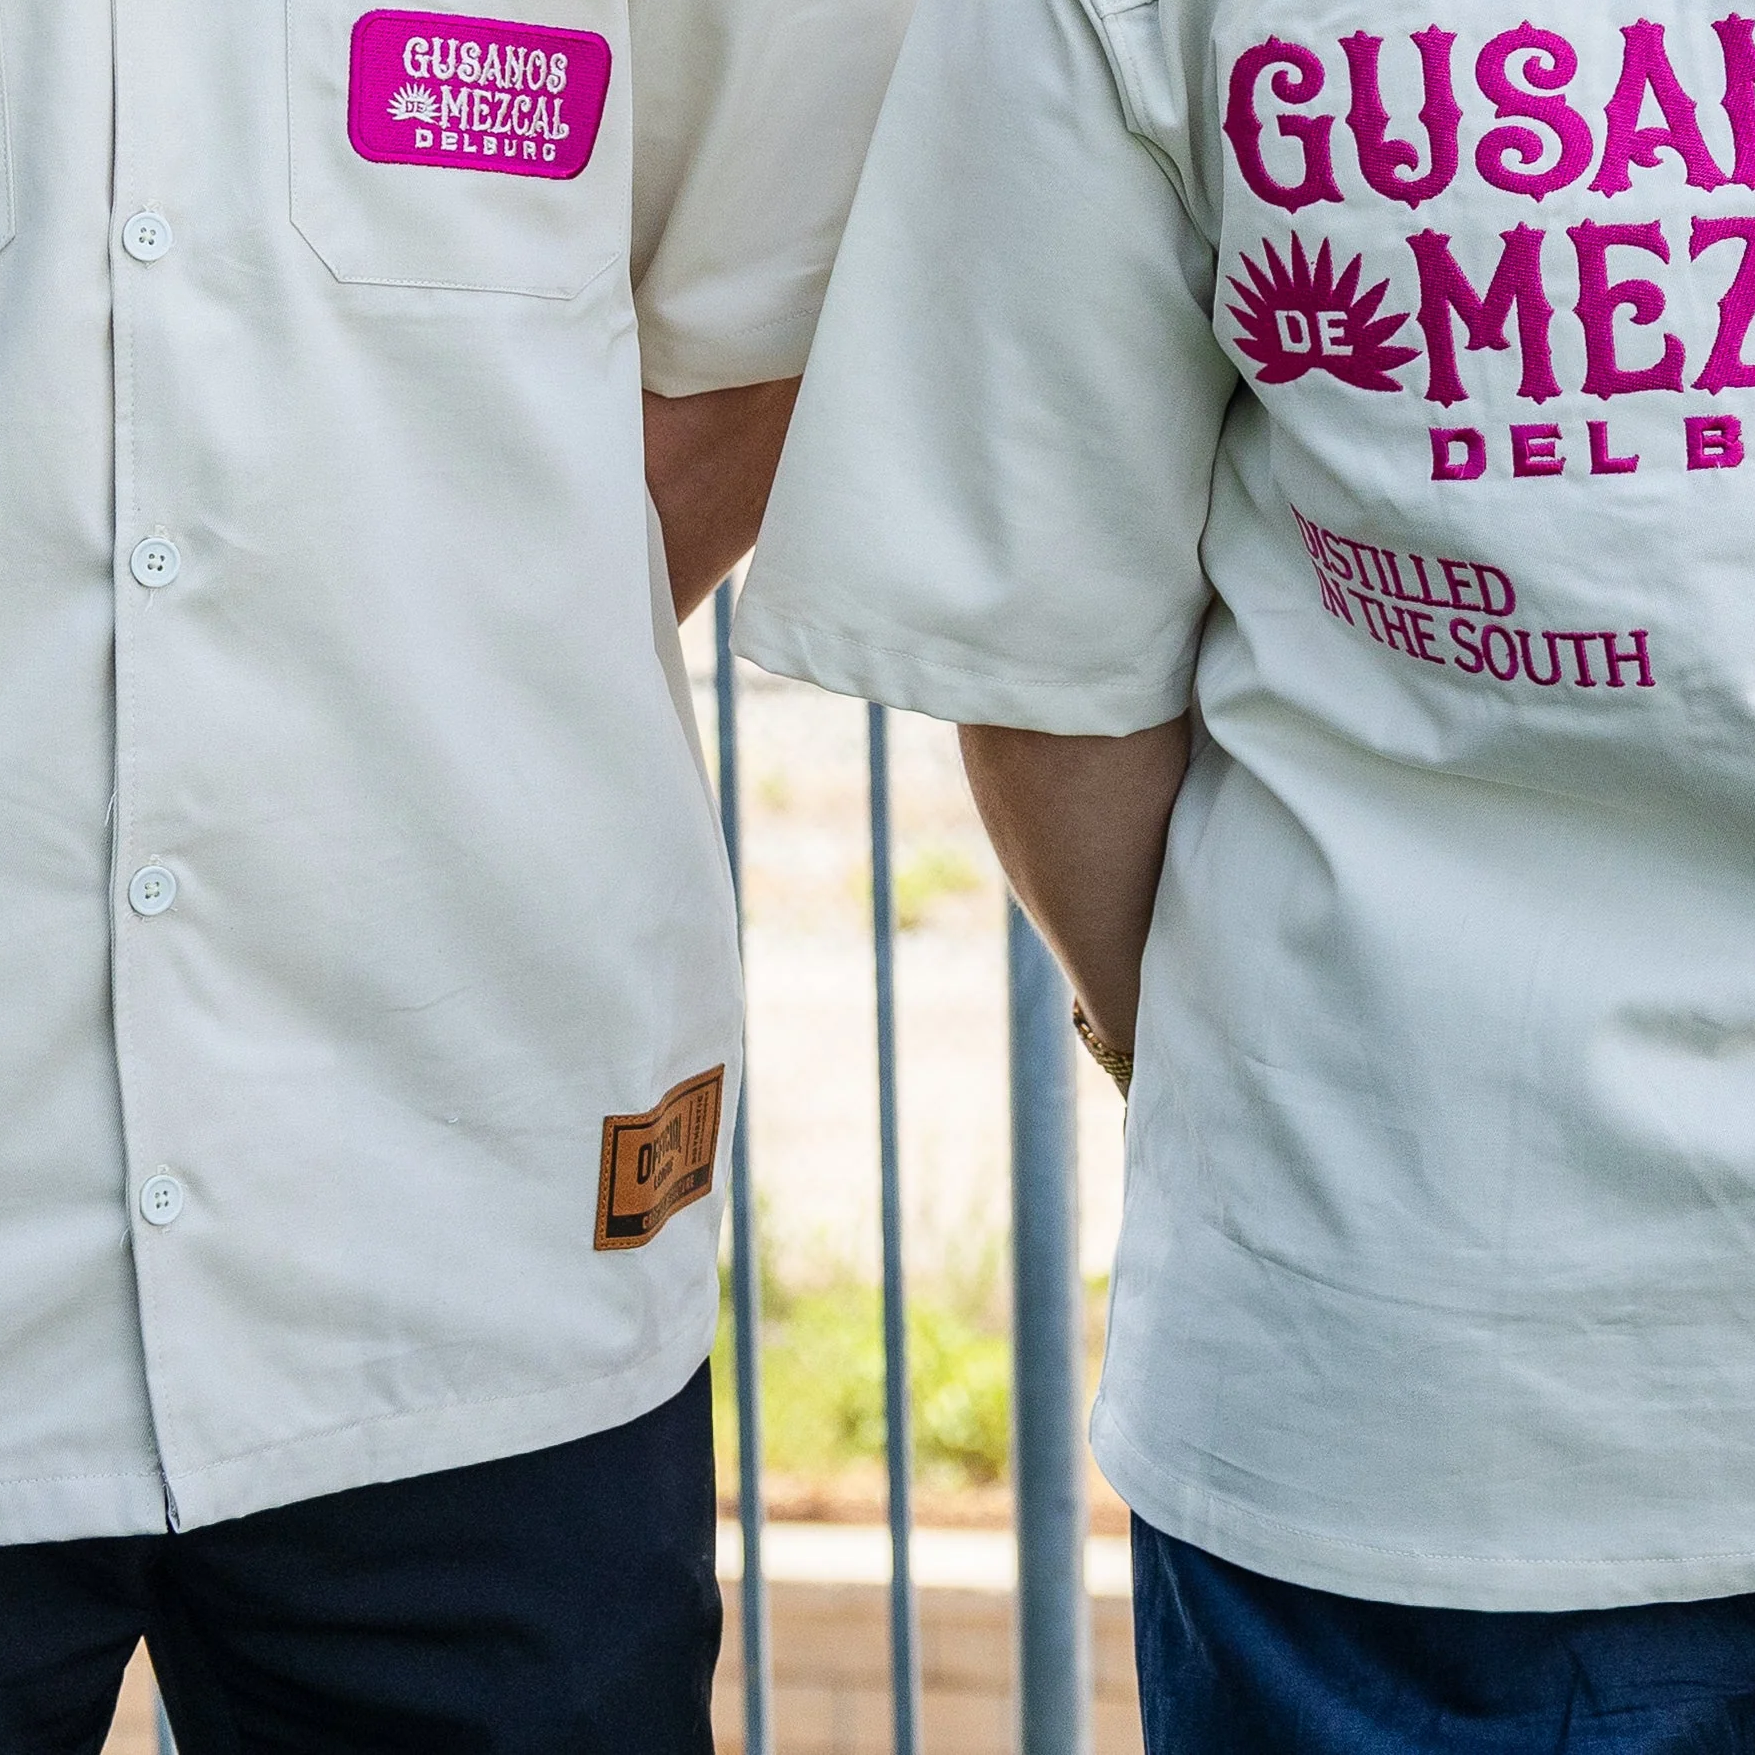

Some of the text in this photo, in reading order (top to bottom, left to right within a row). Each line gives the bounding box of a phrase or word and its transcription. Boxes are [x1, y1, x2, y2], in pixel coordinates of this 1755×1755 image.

[402, 36, 569, 95] GUSANOS
[404, 84, 571, 141] DE MEZCAL
[1275, 309, 1354, 356] DE
[1429, 419, 1641, 482] DEL
[1312, 559, 1656, 687] IN THE SOUTH
